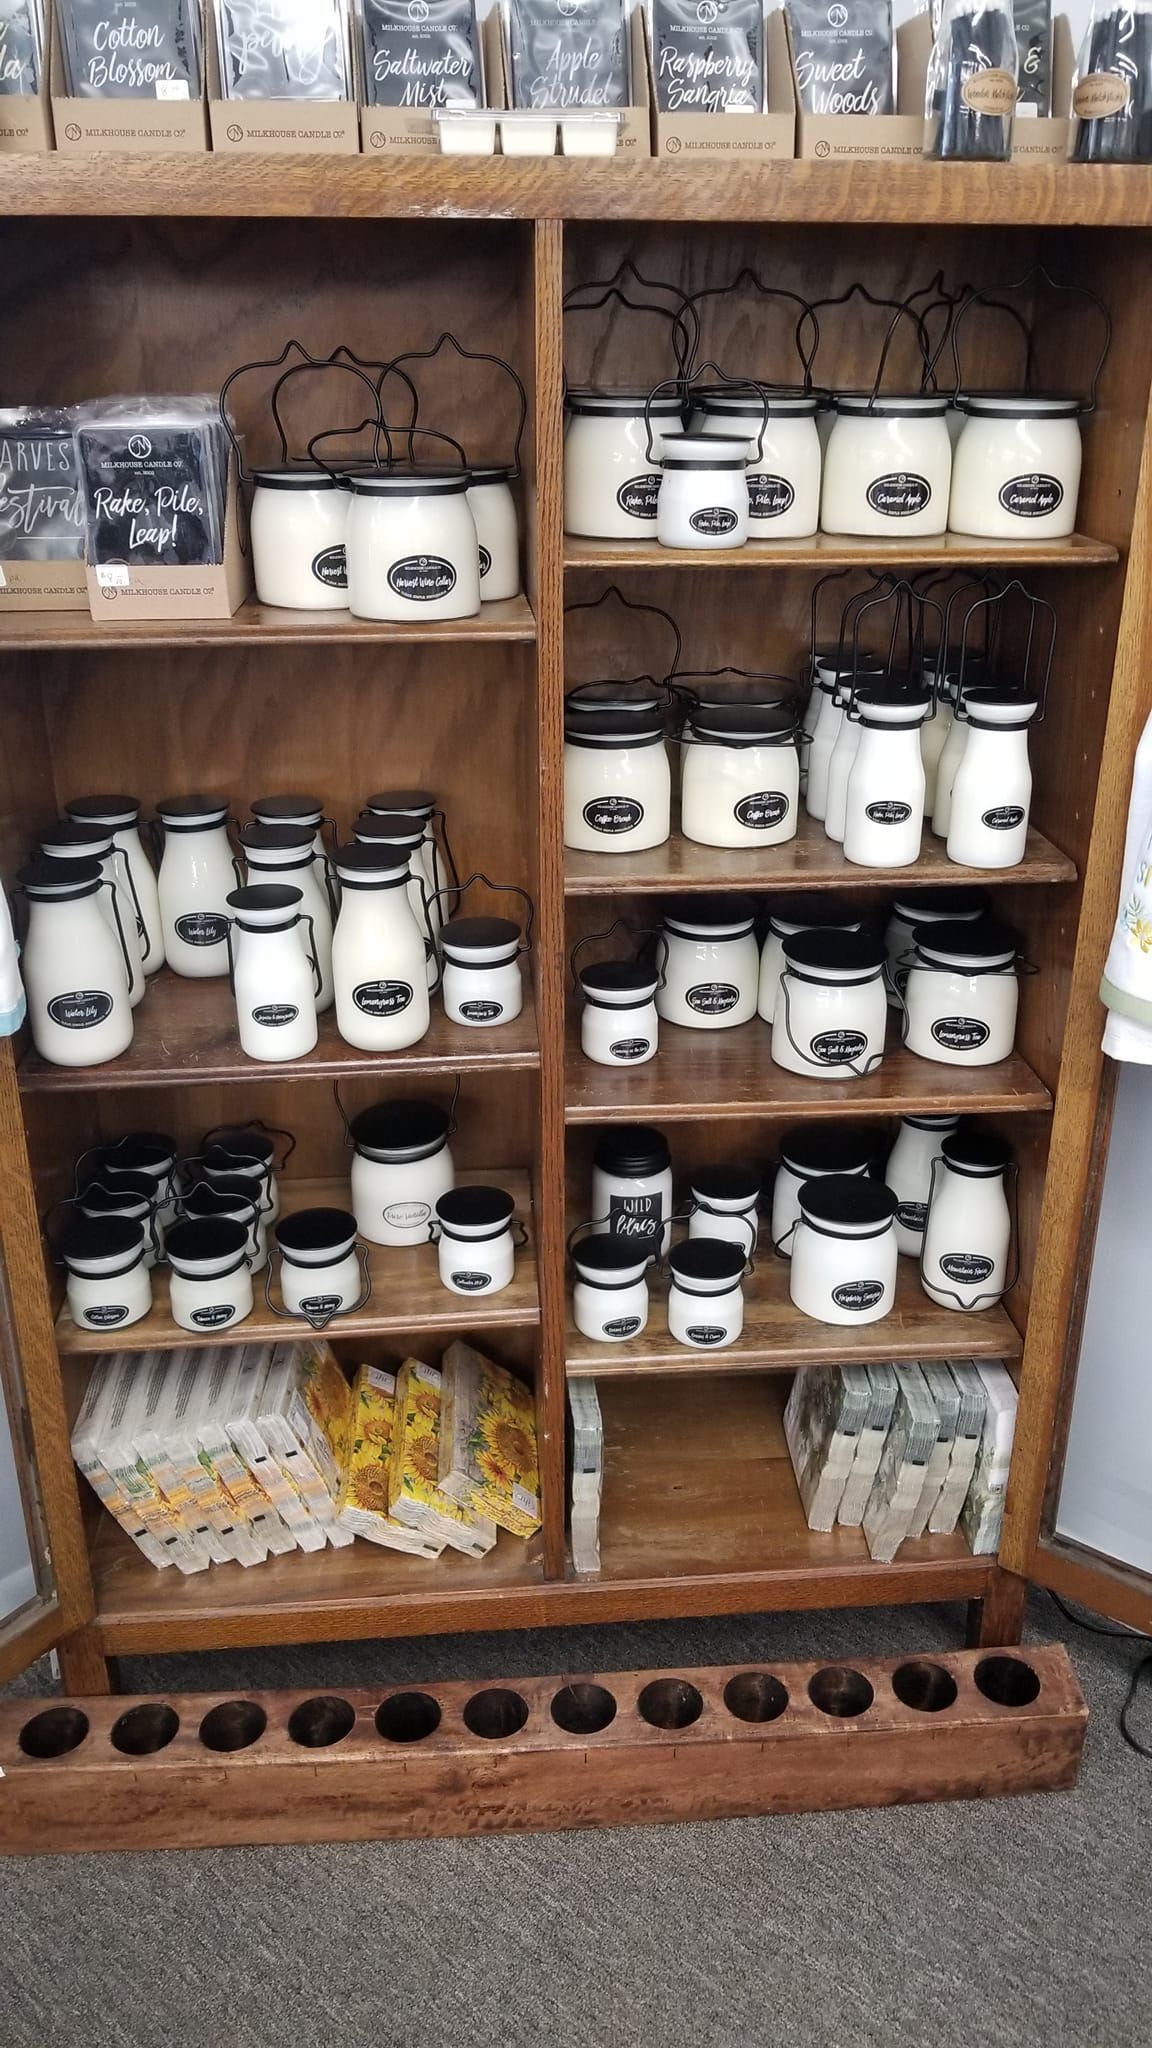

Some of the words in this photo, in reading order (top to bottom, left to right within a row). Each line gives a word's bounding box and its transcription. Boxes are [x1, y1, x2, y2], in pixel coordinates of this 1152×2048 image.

[93, 17, 165, 51] Cotton
[421, 24, 447, 32] CANDLE
[88, 51, 177, 88] Blossom
[373, 48, 472, 81] Saltwater
[546, 36, 601, 81] Apple
[660, 46, 754, 87] Raspberry
[795, 48, 866, 90] Sweet
[399, 78, 448, 108] Mist
[530, 72, 613, 109] Strudel
[667, 79, 750, 113] Sangria
[812, 80, 882, 115] Woods
[86, 129, 136, 137] MILKHOUSE
[138, 129, 173, 137] CANDLE
[247, 130, 296, 138] MILKHOUSE
[298, 130, 331, 138] CANDLE
[389, 136, 438, 144] MILKHOUSE
[685, 141, 730, 150] MILKHOUSE
[732, 142, 763, 150] CANDLE
[833, 145, 879, 154] MILKHOUSE
[880, 146, 911, 155] CANDLE
[0, 439, 70, 471] ARVES
[101, 461, 143, 469] MILKHOUSE
[0, 474, 85, 534] estival
[93, 486, 149, 520] Rake,
[154, 484, 203, 517] Pile,
[129, 514, 178, 552] Leap!
[43, 587, 75, 595] CANDLE
[121, 588, 168, 596] MILKHOUSE
[169, 587, 200, 596] CANDLE
[623, 1197, 652, 1213] WILD
